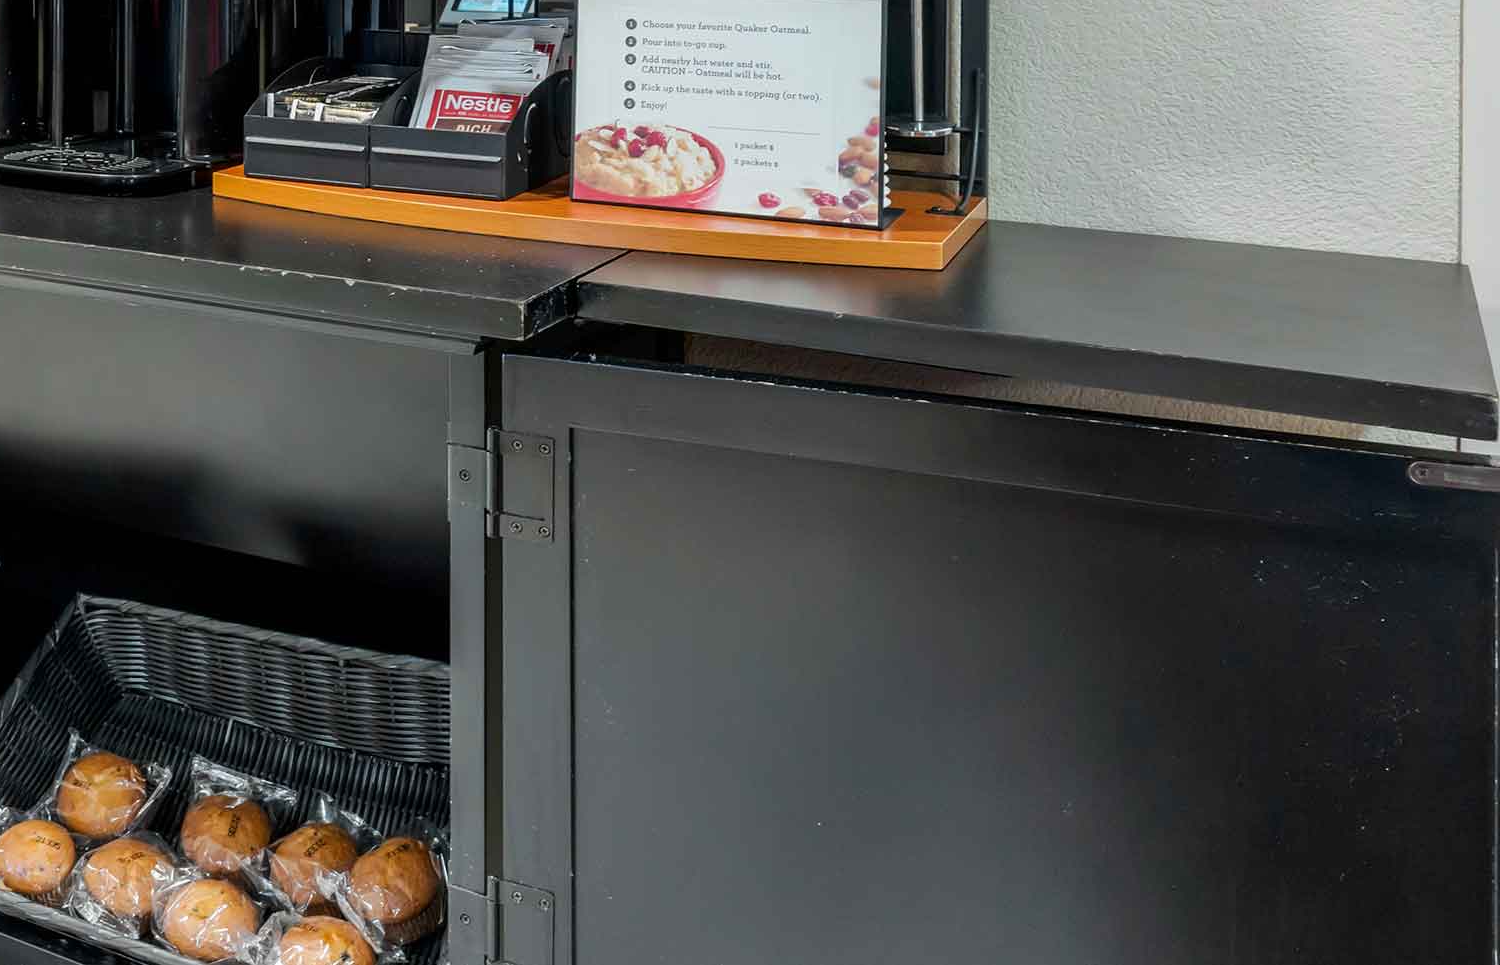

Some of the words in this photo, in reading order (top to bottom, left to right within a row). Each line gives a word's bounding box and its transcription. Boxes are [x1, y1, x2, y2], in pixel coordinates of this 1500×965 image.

[642, 20, 674, 30] Choose
[676, 22, 696, 32] your
[698, 21, 733, 32] favorite
[734, 24, 767, 35] Quaker
[770, 24, 811, 35] Oatmeal.
[642, 37, 662, 47] Pour
[664, 38, 682, 47] into
[684, 39, 707, 50] to-go
[642, 55, 660, 64] Add
[662, 56, 690, 67] nearby
[692, 57, 708, 66] hot
[709, 59, 735, 68] water
[737, 60, 753, 69] and
[755, 61, 773, 70] stir.
[642, 65, 686, 76] CAUTION
[695, 68, 733, 78] Oatmeal
[734, 70, 751, 79] will
[753, 70, 764, 80] be
[766, 72, 784, 81] hot.
[641, 83, 661, 93] Kick
[663, 85, 675, 94] up
[676, 85, 690, 94] the
[692, 86, 714, 96] taste
[716, 87, 736, 97] with
[744, 89, 780, 101] topping
[782, 90, 796, 101] (or
[798, 91, 823, 102] two).
[641, 101, 668, 111] Enjoy!
[739, 142, 768, 152] packet
[740, 158, 772, 169] packets
